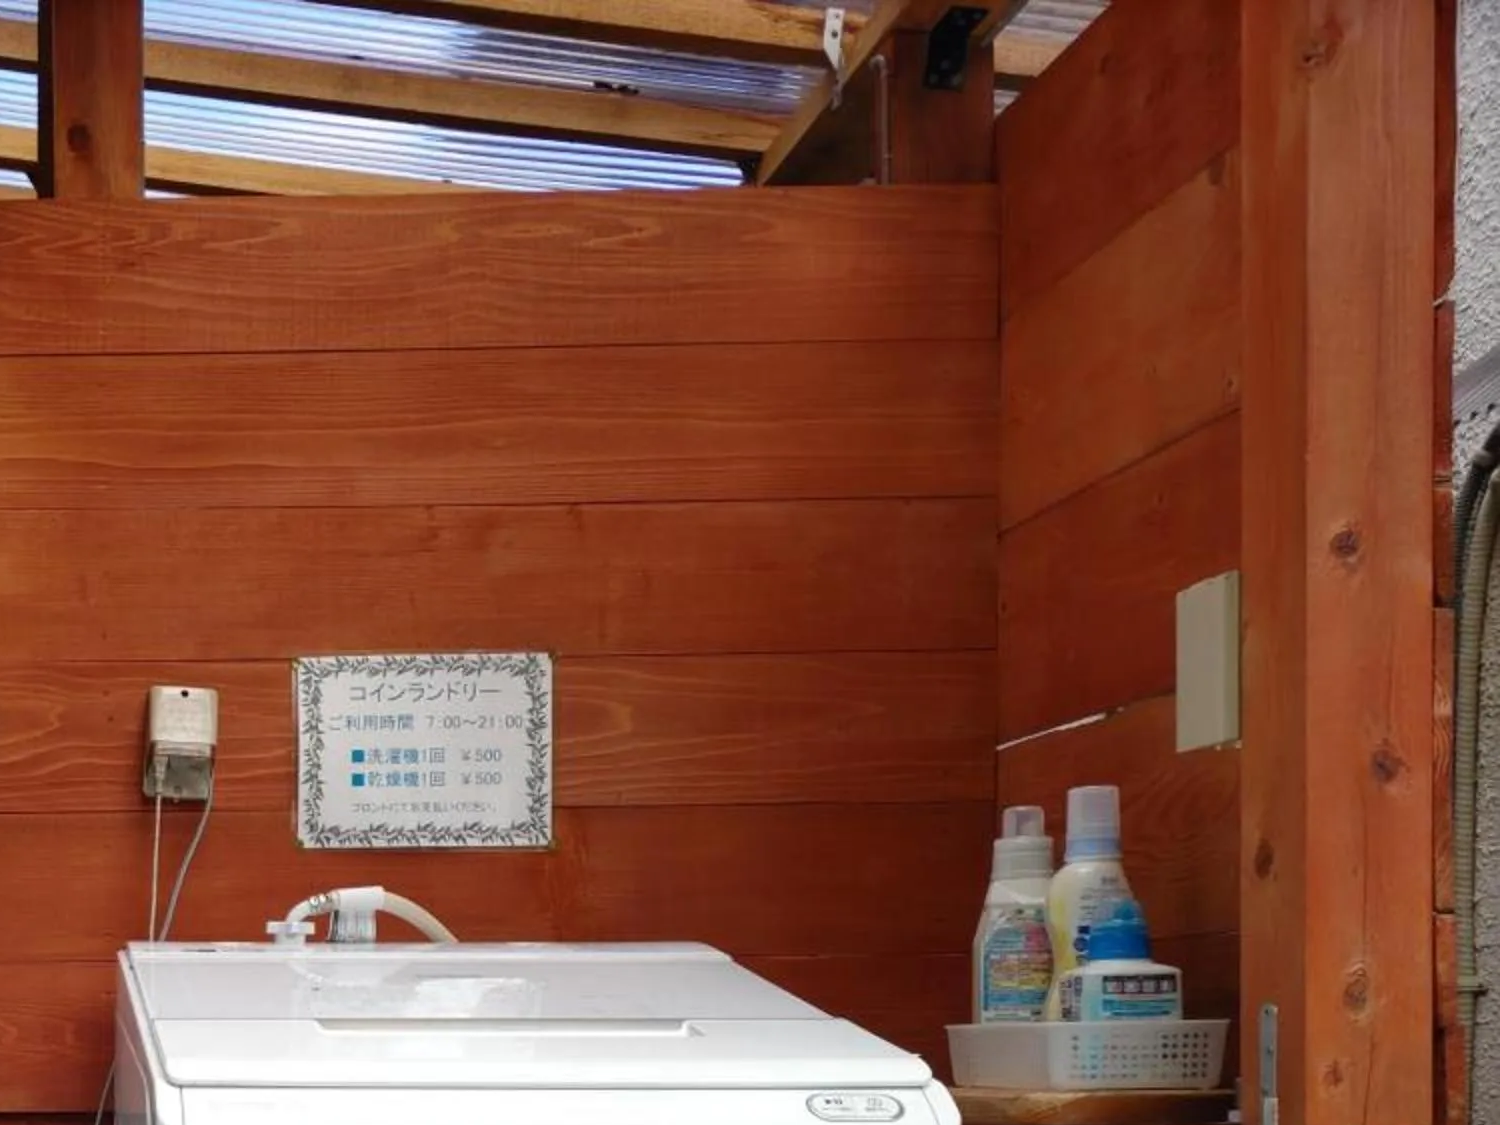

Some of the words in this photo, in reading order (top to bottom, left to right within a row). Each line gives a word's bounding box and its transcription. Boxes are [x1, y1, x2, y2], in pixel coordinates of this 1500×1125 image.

[349, 682, 502, 702] コインランドリー
[329, 713, 415, 731] ご利用時間
